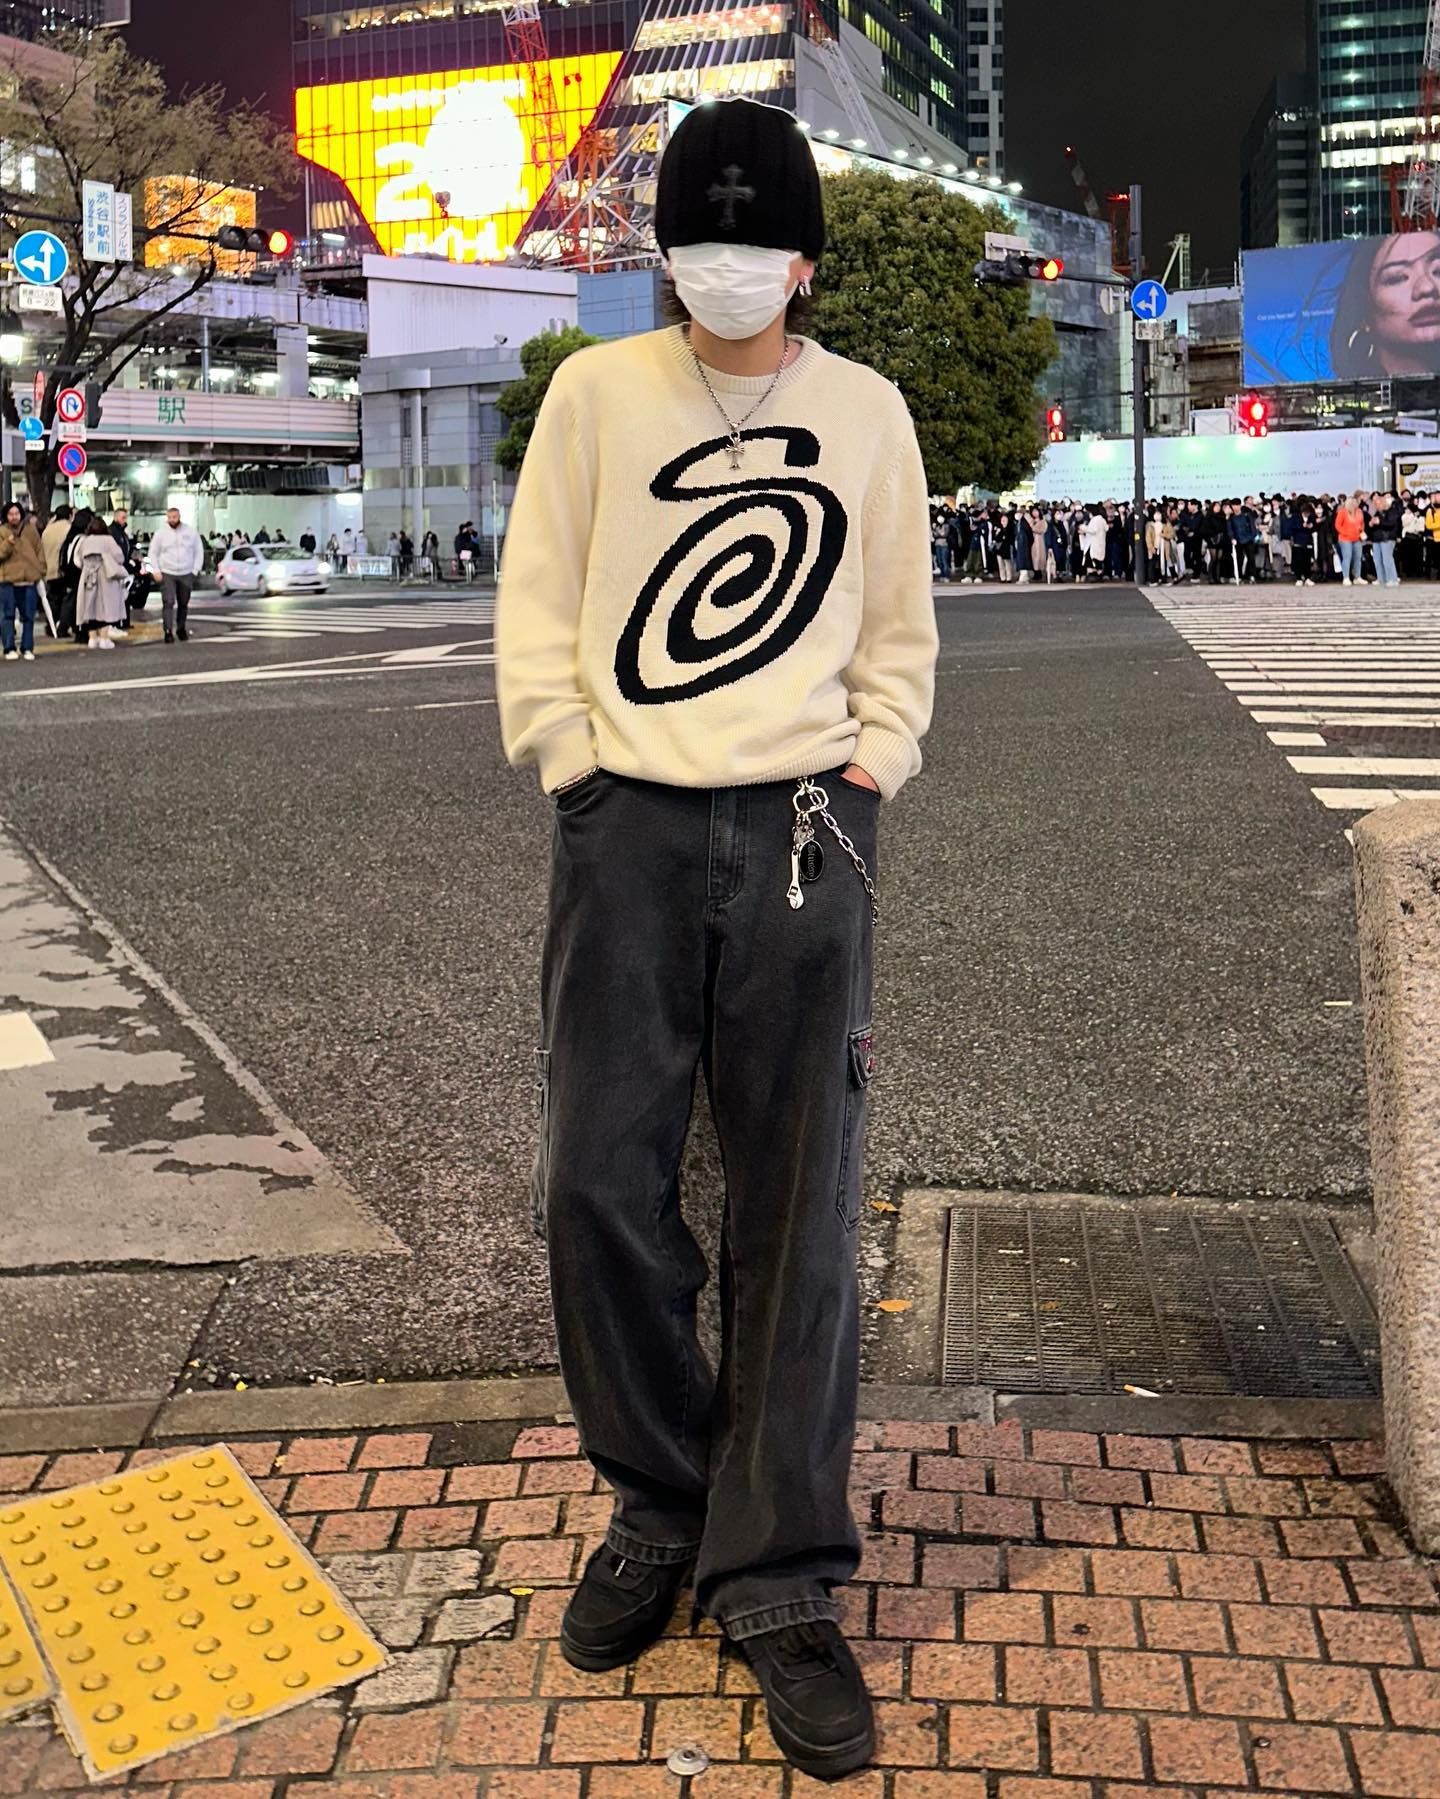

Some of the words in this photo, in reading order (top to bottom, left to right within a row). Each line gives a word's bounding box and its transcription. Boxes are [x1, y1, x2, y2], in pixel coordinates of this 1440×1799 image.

[96, 191, 109, 255] 渋谷駅前
[159, 396, 186, 425] 駅
